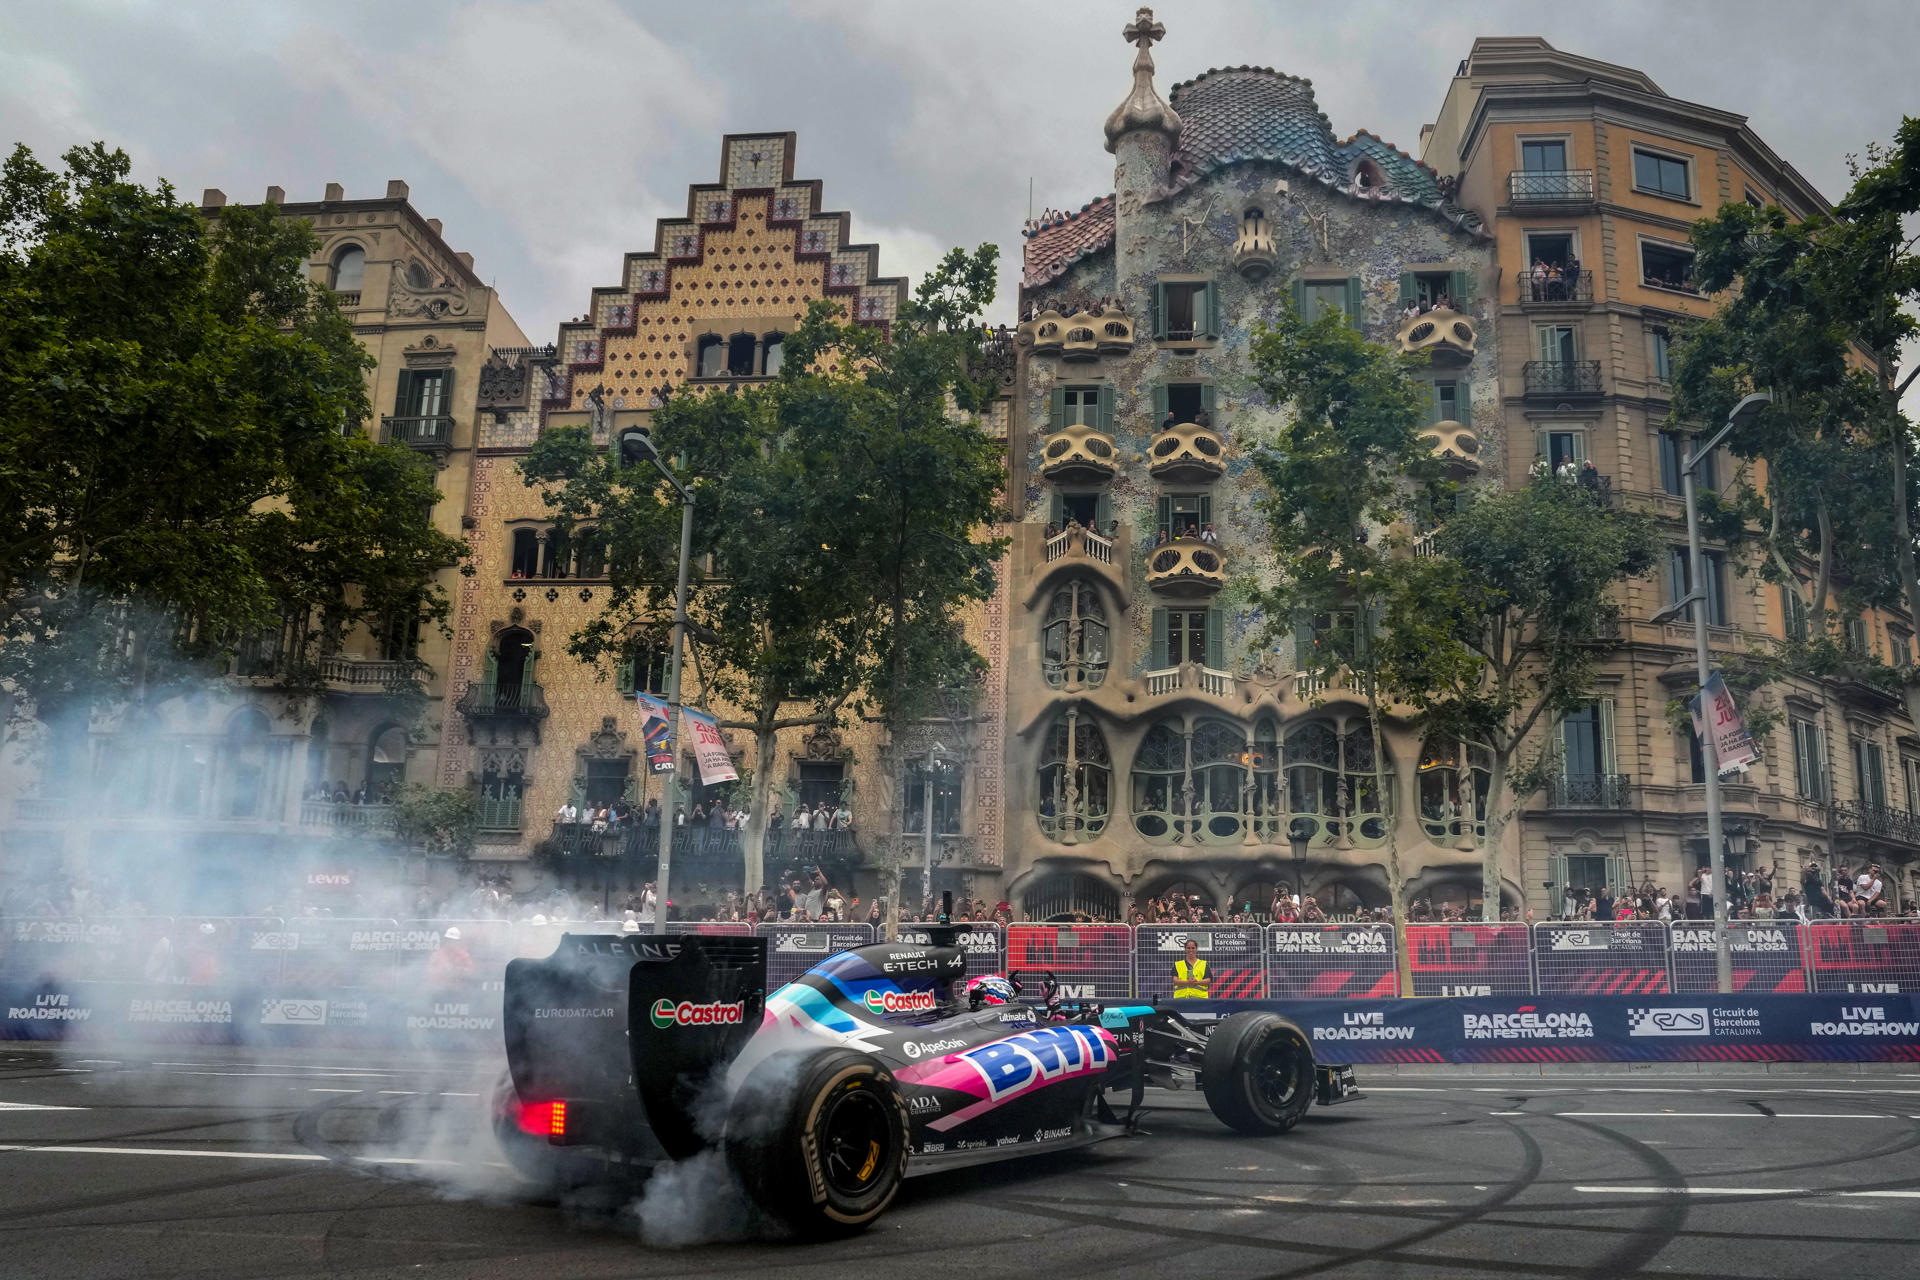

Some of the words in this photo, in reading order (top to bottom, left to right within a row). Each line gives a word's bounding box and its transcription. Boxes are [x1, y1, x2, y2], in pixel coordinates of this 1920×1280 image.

[1214, 932, 1236, 940] Circuit
[1632, 930, 1640, 938] de
[967, 944, 996, 953] 2024
[1276, 944, 1300, 953] FAN
[1357, 944, 1387, 953] 2024
[1674, 943, 1698, 951] FAN
[1757, 943, 1788, 951] 2024
[890, 951, 926, 960] RENAULT
[883, 960, 938, 972] E-TECH
[1059, 985, 1096, 998] IVE
[36, 994, 69, 1006] LIVE
[883, 988, 936, 1012] Castrol
[130, 1000, 232, 1013] BARCELONA
[434, 1003, 470, 1015] LIVE
[677, 1000, 745, 1025] Castrol
[1712, 1008, 1745, 1017] Circuit
[1746, 1008, 1759, 1017] de
[8, 1008, 91, 1020] ROADSHOW
[203, 1013, 232, 1023] 2024
[534, 1008, 614, 1018] EURODATACAR
[1344, 1012, 1384, 1025] LIVE
[1841, 1007, 1885, 1020] LIVE
[407, 1016, 496, 1030] ROADSHOW
[1463, 1012, 1593, 1028] BARCELONA
[1713, 1018, 1760, 1027] Barcelona
[1313, 1027, 1415, 1040] ROADSHOW
[1464, 1028, 1492, 1039] FAN
[1493, 1028, 1557, 1039] FESTIVAL
[1558, 1028, 1594, 1038] 2024
[1714, 1028, 1762, 1036] CATALUNYA
[1811, 1022, 1919, 1035] ROADSHOW
[920, 1038, 967, 1054] ApeCoin
[956, 1025, 1108, 1102] BWT
[909, 1095, 941, 1110] ADA
[1043, 1127, 1071, 1139] BINANCE
[997, 1134, 1020, 1147] yahoo!
